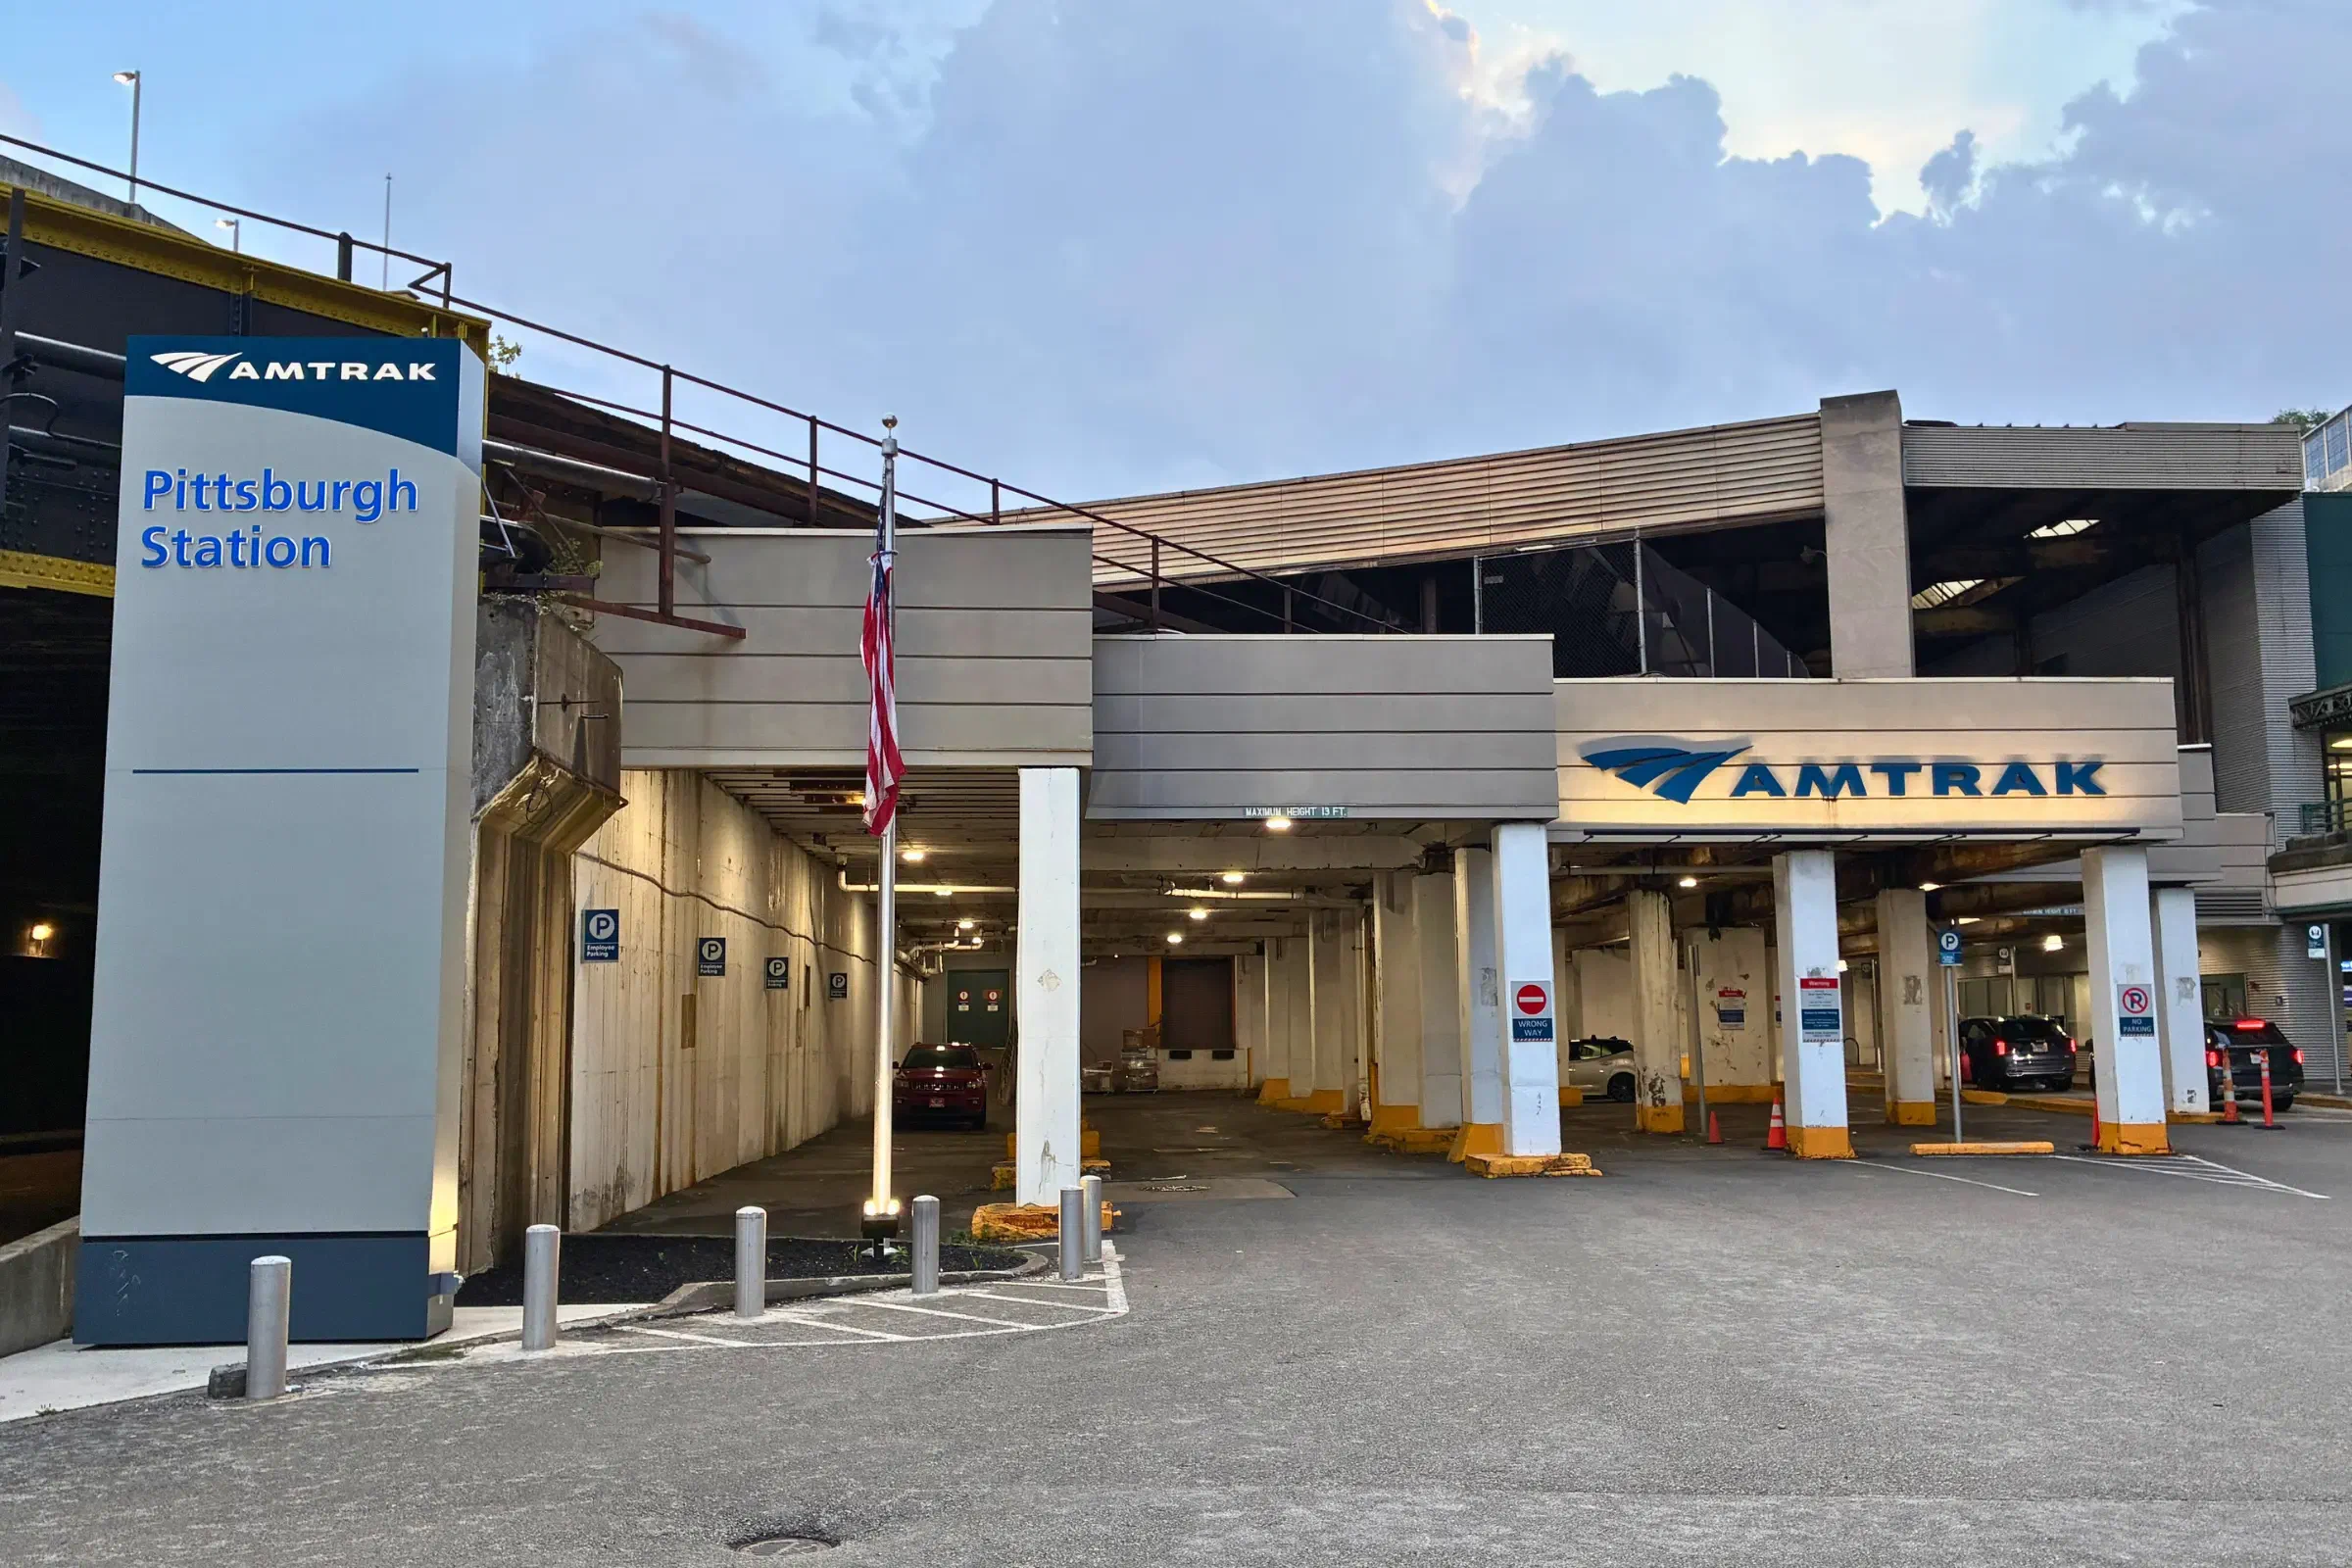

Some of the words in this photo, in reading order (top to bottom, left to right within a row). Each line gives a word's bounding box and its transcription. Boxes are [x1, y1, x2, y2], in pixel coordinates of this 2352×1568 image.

[228, 362, 436, 381] AMTRAK
[143, 467, 419, 523] Pittsburgh
[141, 525, 332, 568] Station
[1729, 761, 2108, 797] AMTRAK
[1246, 807, 1282, 816] MAXIMUM
[1286, 807, 1317, 816] HEIGHT
[1321, 807, 1331, 816] 13
[596, 917, 611, 936] P
[1946, 935, 1955, 948] P
[708, 944, 718, 957] P
[773, 962, 782, 974] P
[836, 977, 844, 986] P
